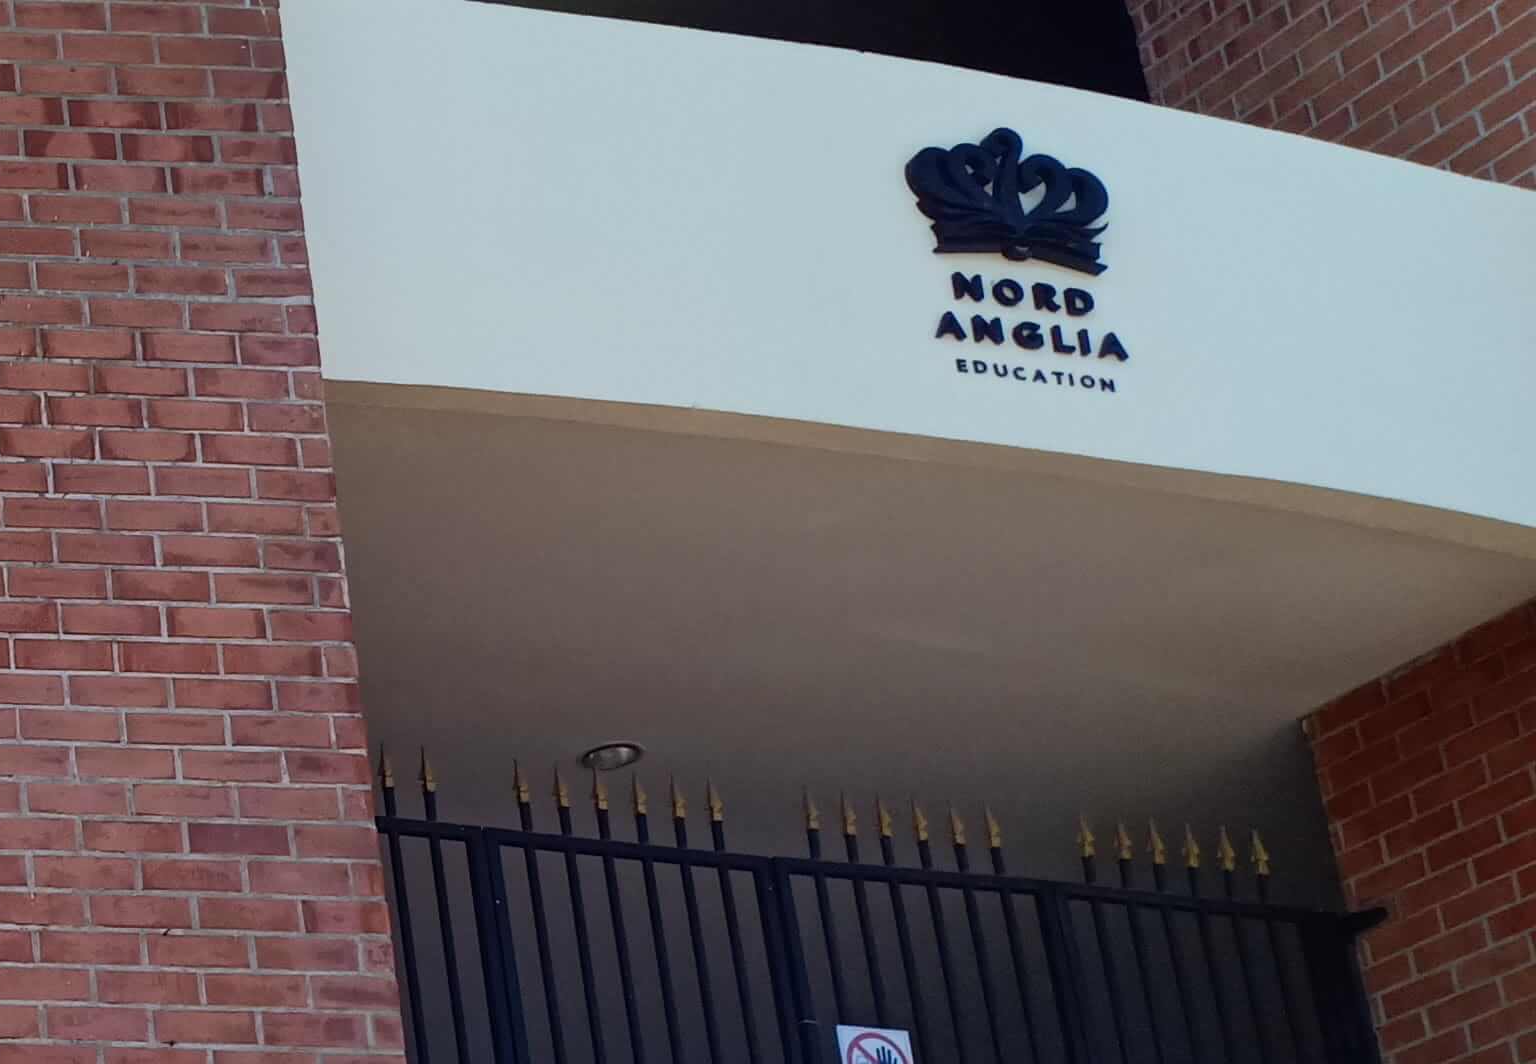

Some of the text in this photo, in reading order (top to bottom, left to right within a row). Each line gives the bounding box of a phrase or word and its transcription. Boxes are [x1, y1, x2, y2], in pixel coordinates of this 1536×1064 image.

[950, 270, 1095, 317] NORD
[935, 310, 1129, 362] ANGLIA
[955, 358, 1116, 393] EDUCATION
